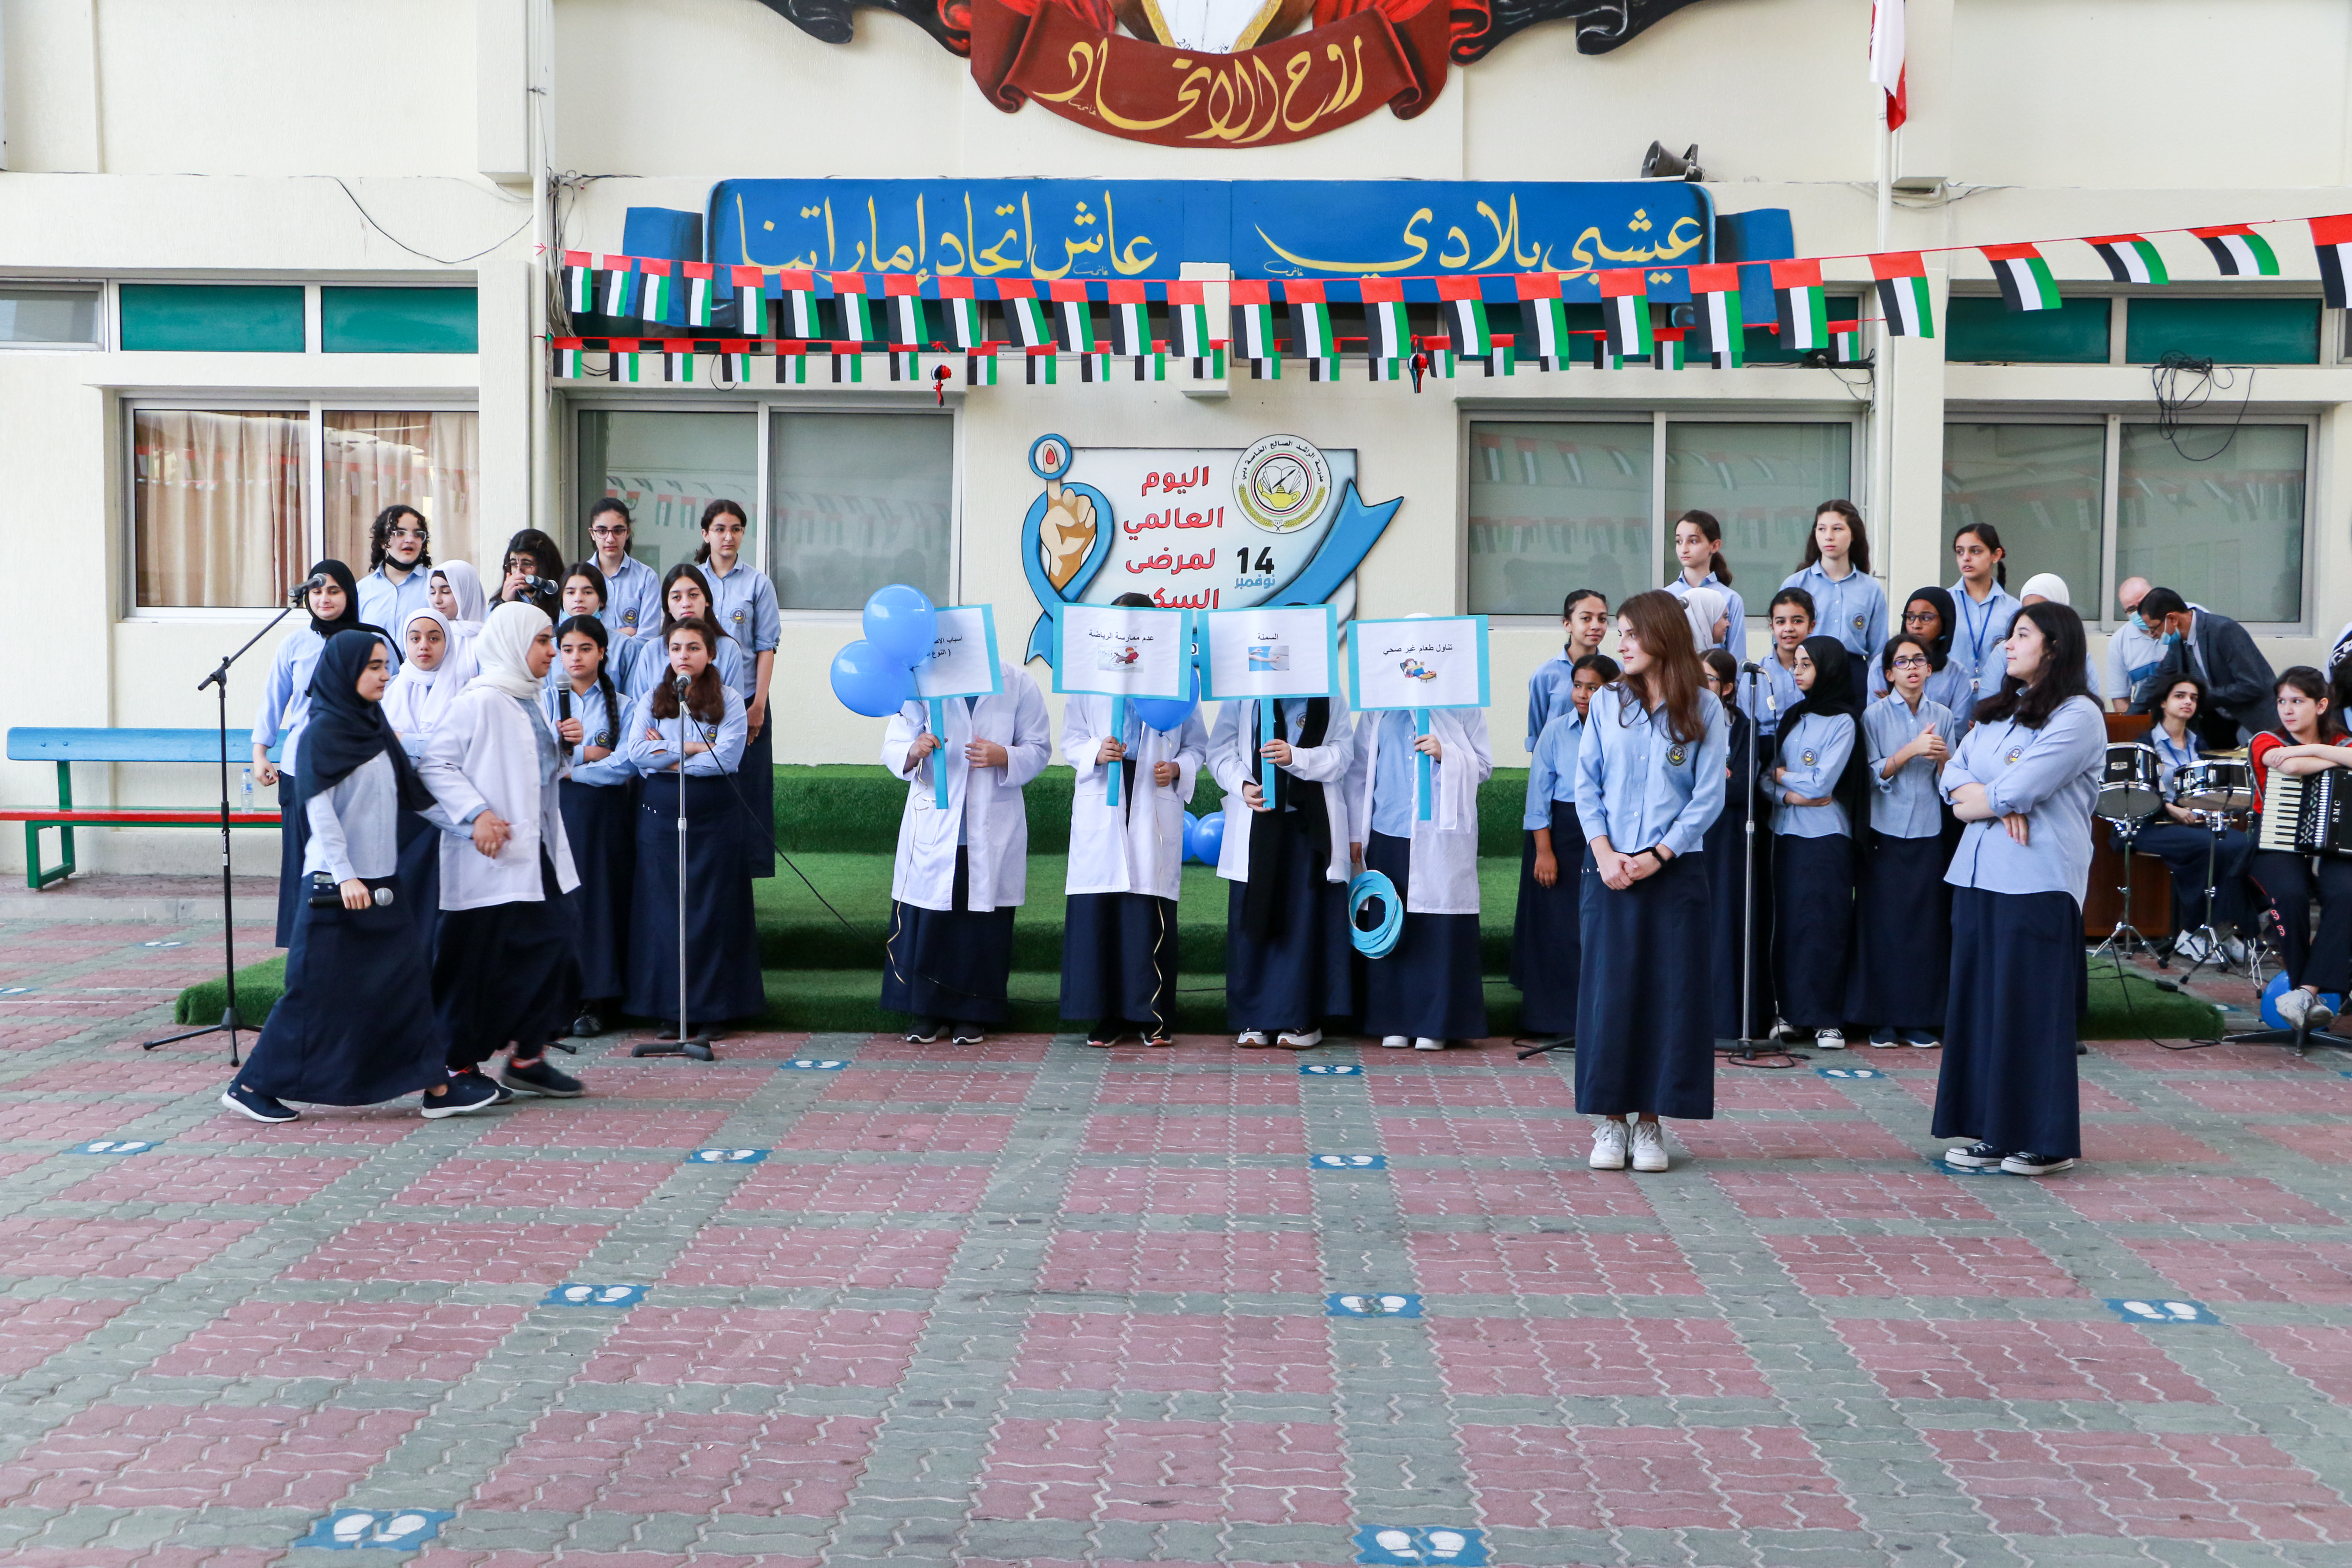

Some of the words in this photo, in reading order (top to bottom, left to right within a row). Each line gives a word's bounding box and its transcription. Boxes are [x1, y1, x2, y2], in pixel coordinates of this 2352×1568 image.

[1032, 37, 1279, 143] الاتحاد
[1283, 35, 1363, 132] روح
[936, 190, 1032, 276] اتحاد
[1030, 190, 1158, 280] عاش
[1254, 192, 1541, 279] بلادي
[1245, 444, 1267, 465] الخاصة
[1270, 440, 1293, 449] الصالح
[1296, 444, 1315, 459] الراشد
[1314, 458, 1324, 482] مدرسة
[1142, 466, 1209, 497] اليوم
[1123, 506, 1224, 540] العالمي
[1125, 547, 1215, 575] لمرضى
[1237, 546, 1275, 574] 14
[1234, 574, 1275, 589] نوفمبر
[1089, 629, 1113, 640] الرياضة
[1115, 632, 1140, 642] ممارسة
[1257, 632, 1279, 640] السمنة
[1383, 647, 1402, 655] صحي
[1404, 644, 1416, 653] غير
[1419, 644, 1434, 654] طعام
[1436, 644, 1452, 652] تناول
[2331, 800, 2341, 823] SMC
